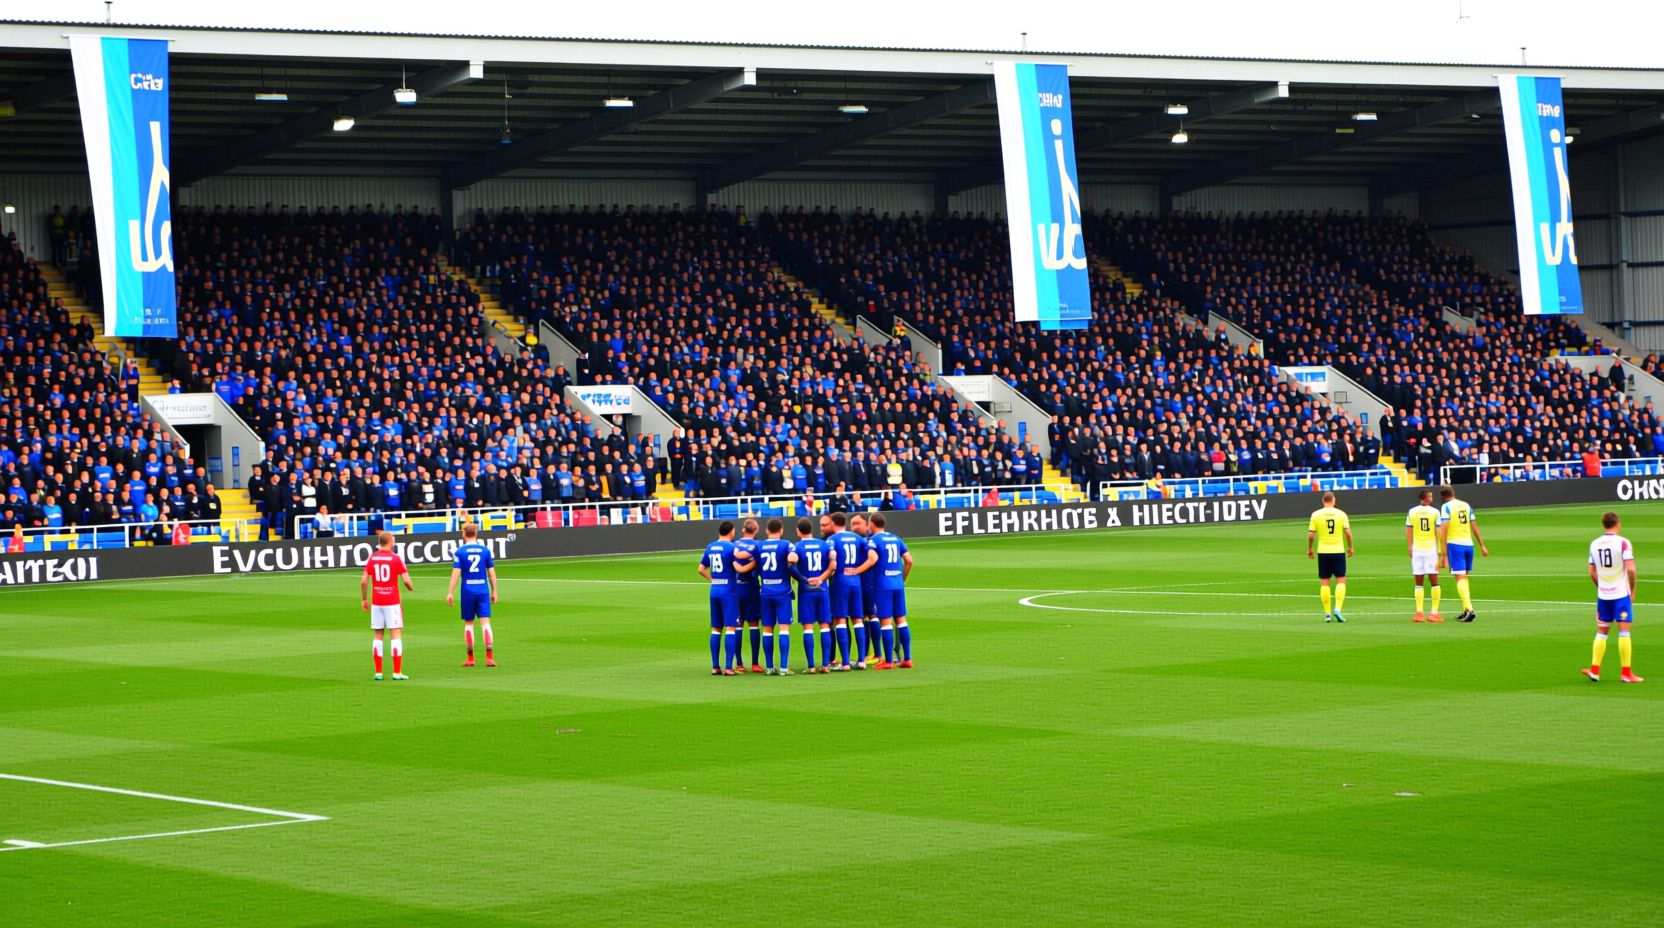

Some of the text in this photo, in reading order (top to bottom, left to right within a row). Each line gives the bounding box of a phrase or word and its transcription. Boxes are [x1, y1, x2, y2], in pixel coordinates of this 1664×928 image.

[1326, 519, 1335, 534] 9
[468, 554, 480, 573] 2
[374, 564, 390, 583] 10
